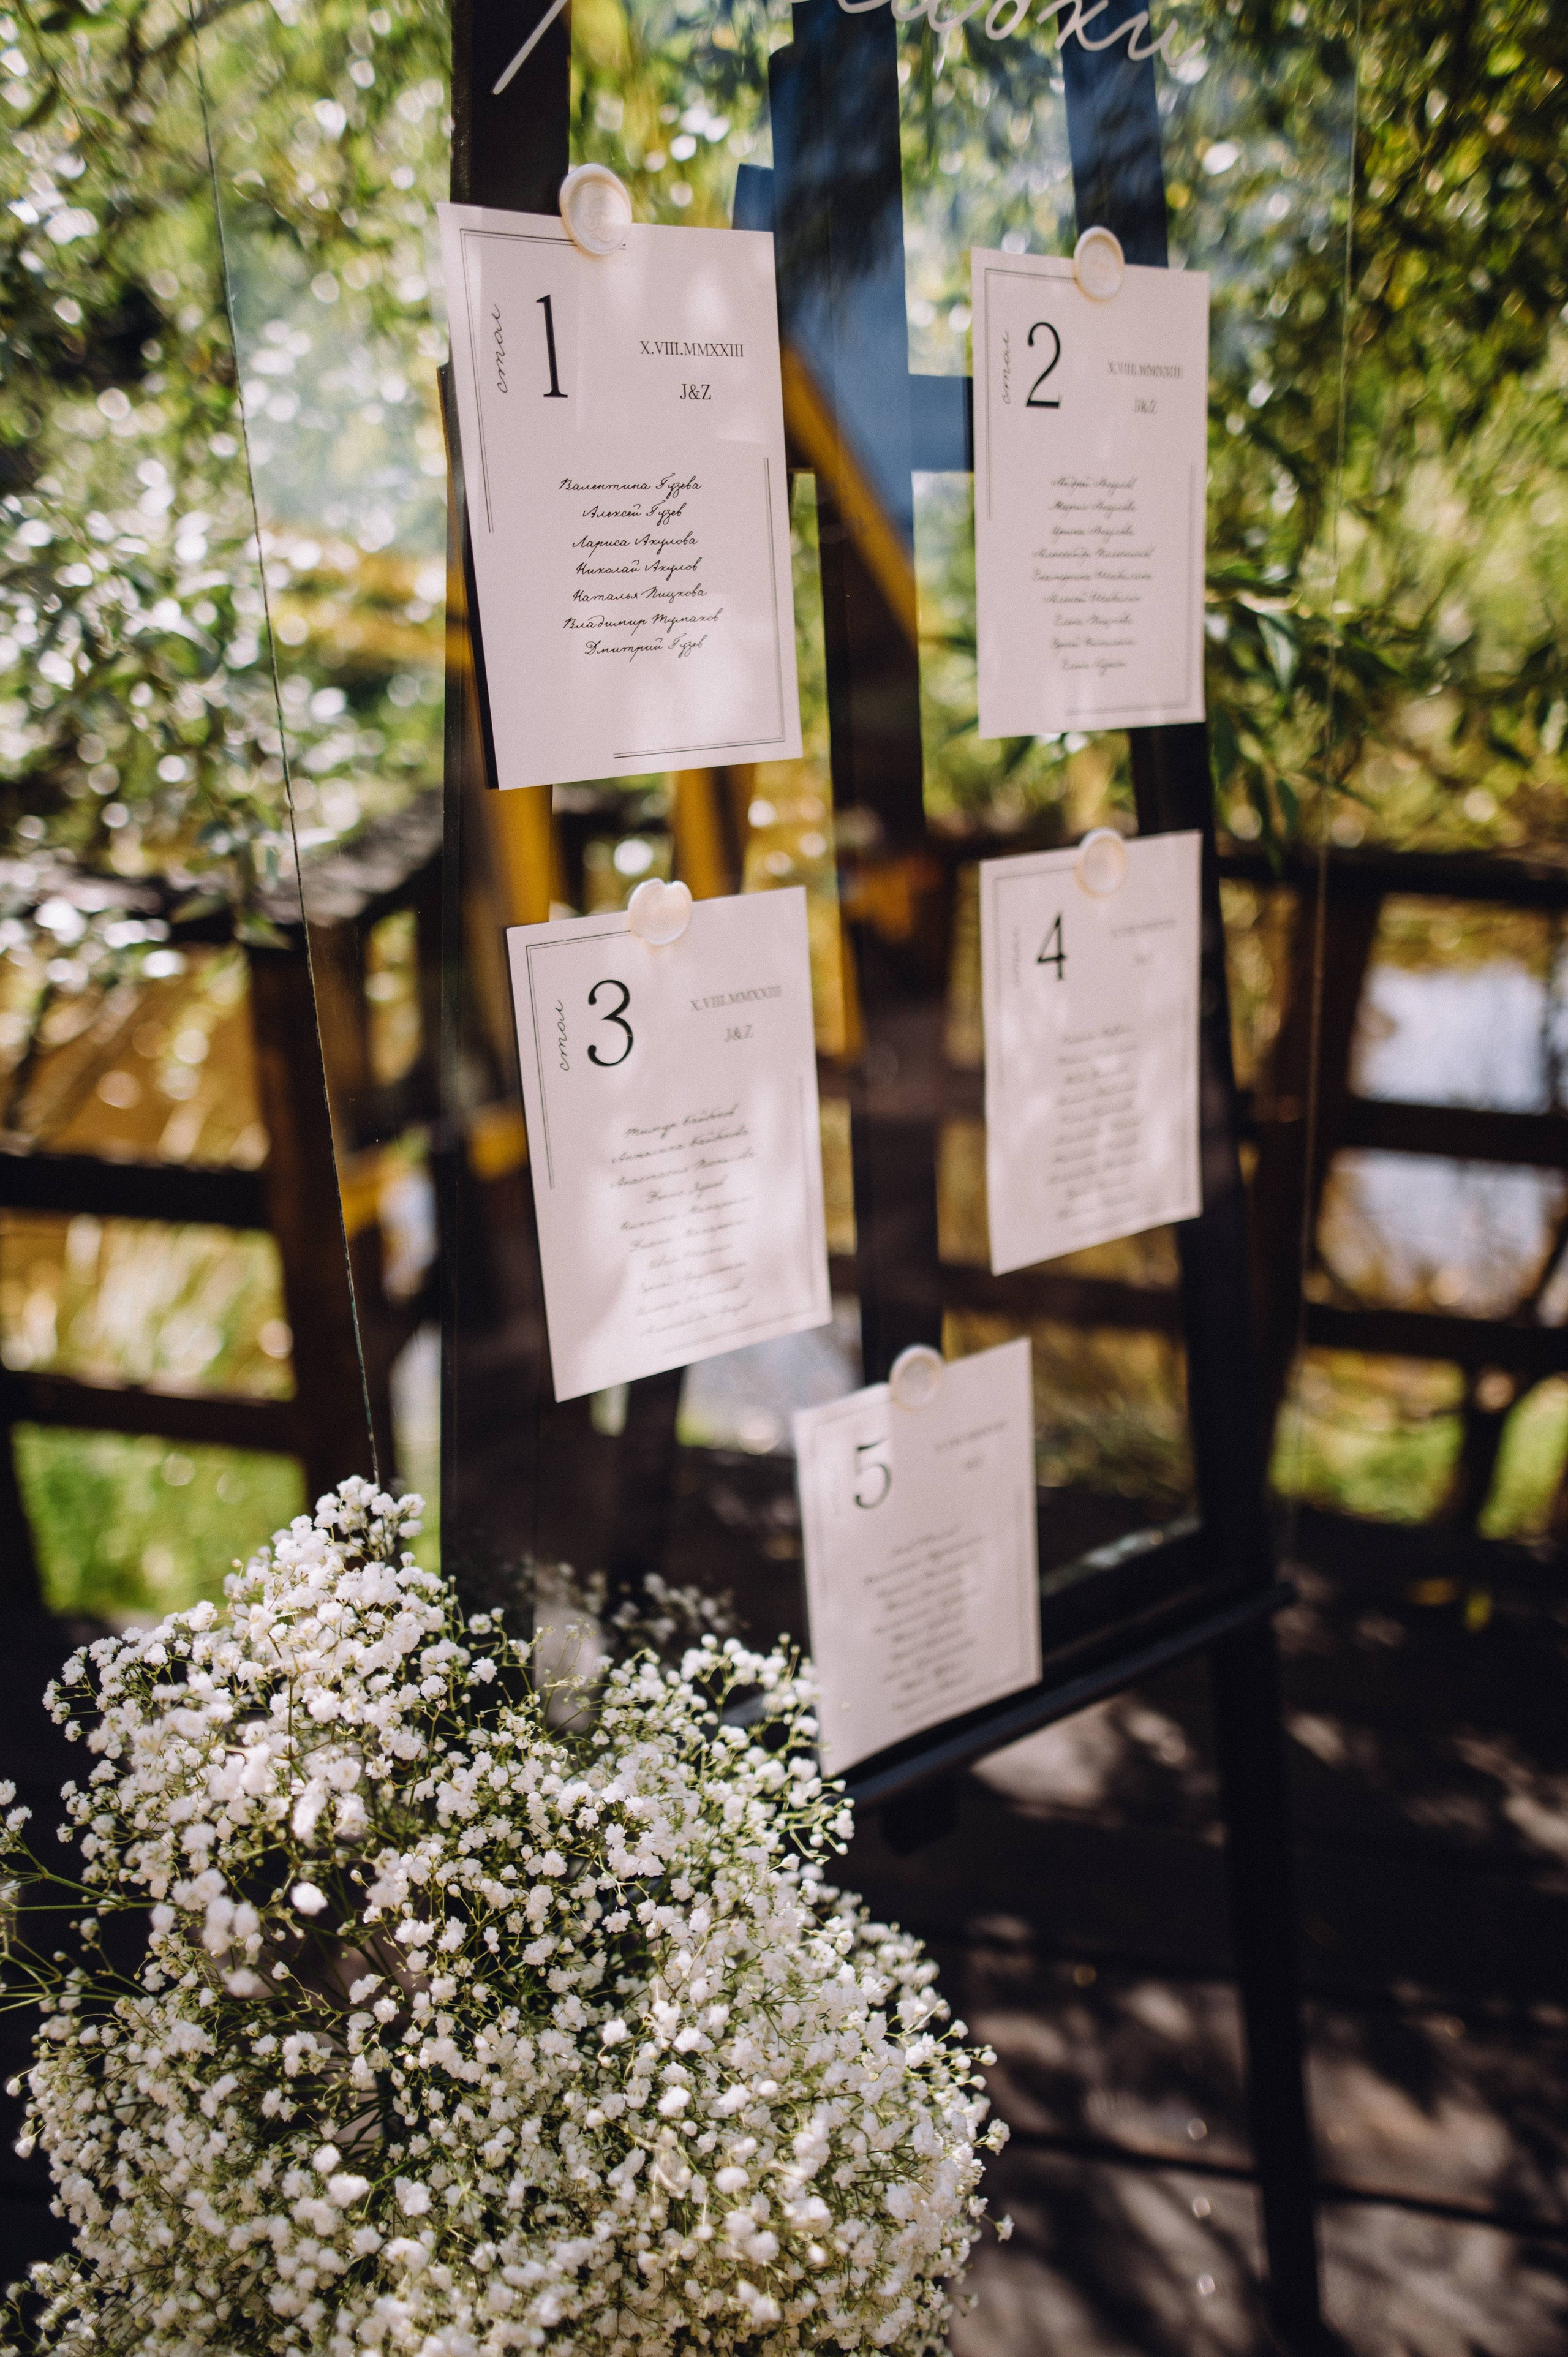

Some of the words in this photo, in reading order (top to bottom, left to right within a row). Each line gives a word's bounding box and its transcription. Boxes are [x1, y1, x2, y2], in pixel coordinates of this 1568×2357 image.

[536, 294, 568, 398] 1
[639, 341, 744, 358] X.VIII.MMXXIII
[1026, 322, 1061, 408] 2
[680, 384, 712, 401] J&Z
[559, 478, 650, 491] Валентина
[655, 473, 702, 499] Гузева
[582, 503, 641, 518] Алексей
[646, 500, 687, 526] Гузев
[572, 535, 630, 558] Лариса
[635, 531, 698, 555] Акулова
[576, 560, 640, 575] Николай
[645, 557, 702, 581] Акулов
[573, 589, 638, 602] Наталья
[563, 614, 647, 636] Владимир
[652, 608, 723, 633] Тумаков
[584, 638, 663, 662] Дмитрий
[668, 633, 707, 658] Гузев
[1035, 911, 1068, 980] 4
[587, 979, 633, 1066] 3
[854, 1436, 891, 1509] 5
